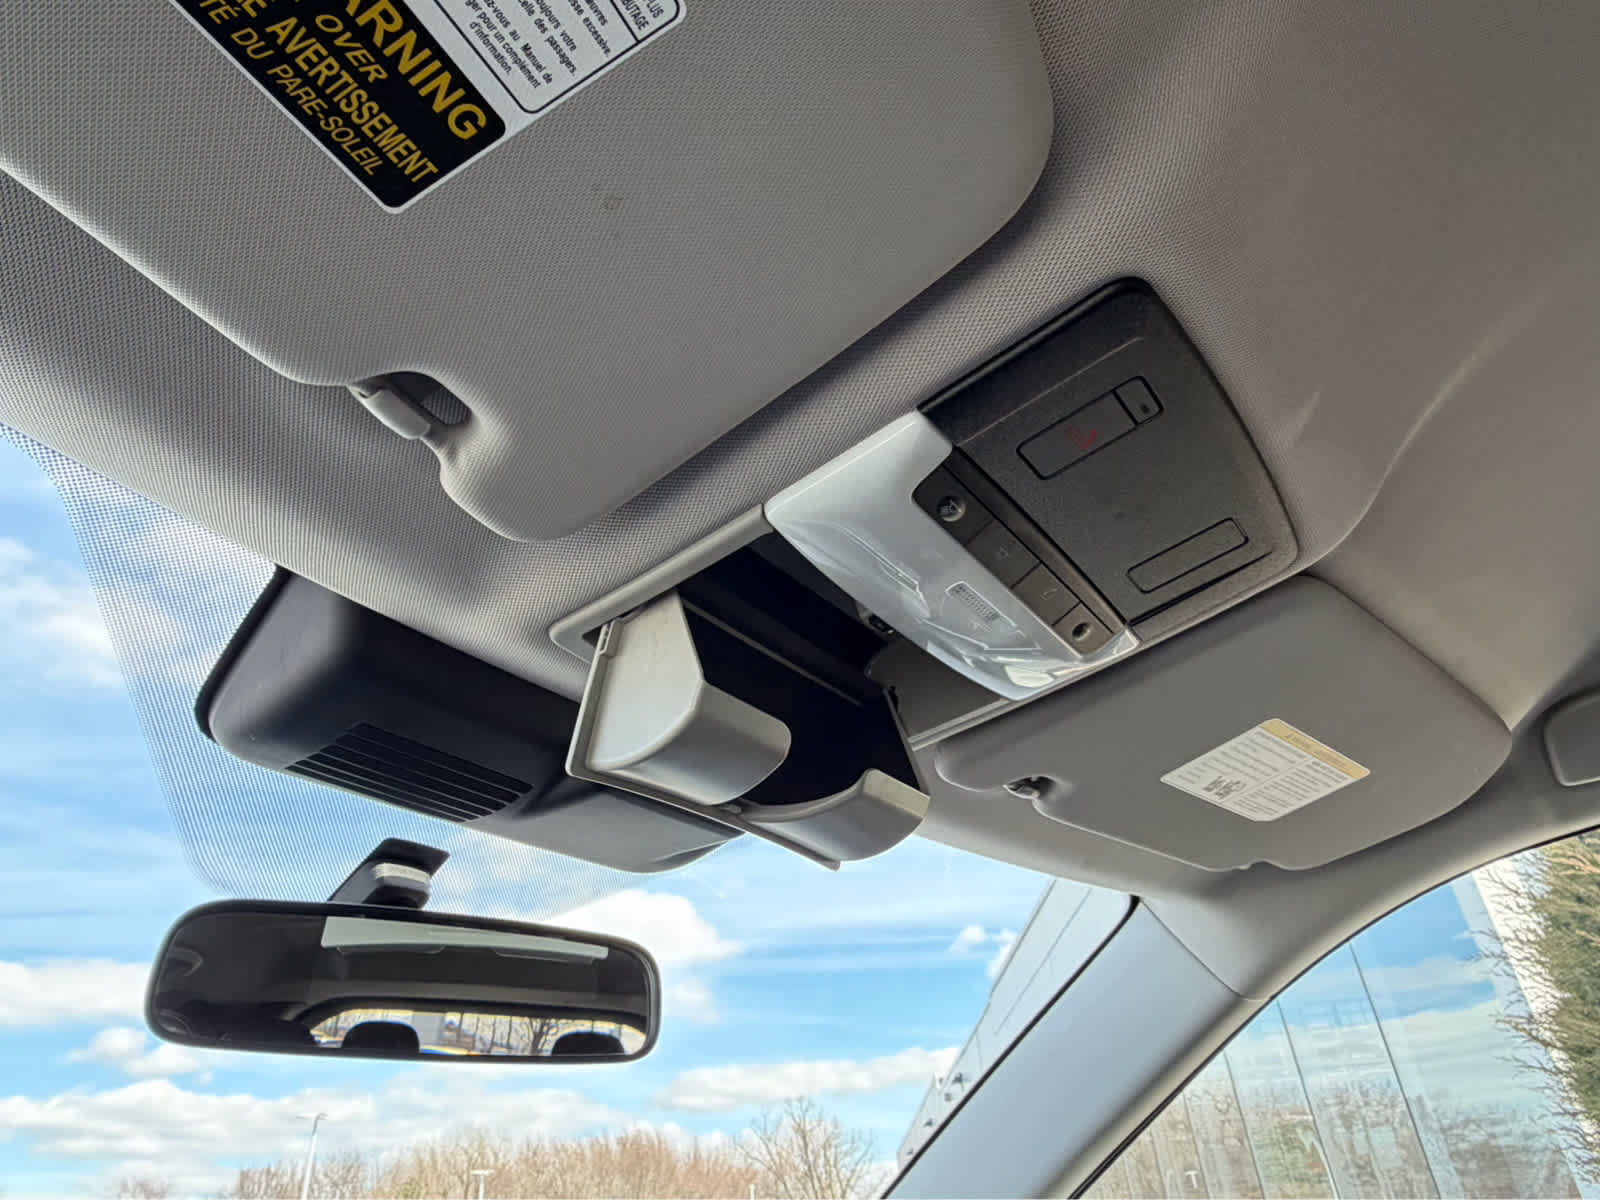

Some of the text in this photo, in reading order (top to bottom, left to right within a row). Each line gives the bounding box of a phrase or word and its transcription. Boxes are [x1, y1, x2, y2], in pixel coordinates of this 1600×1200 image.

[518, 0, 576, 76] elle des passagers.
[560, 30, 576, 52] votre
[567, 0, 584, 16] sse
[645, 0, 664, 18] LUS
[315, 14, 388, 83] OVER
[345, 0, 487, 140] RNING
[476, 11, 497, 32] pour
[494, 31, 505, 44] un
[502, 42, 541, 89] complément
[509, 29, 520, 42] au
[520, 43, 547, 73] Manuel
[542, 72, 553, 84] de
[230, 27, 275, 59] DU
[267, 64, 383, 176] PARE-SOLEIL
[265, 16, 438, 182] AVERTISSEMENT
